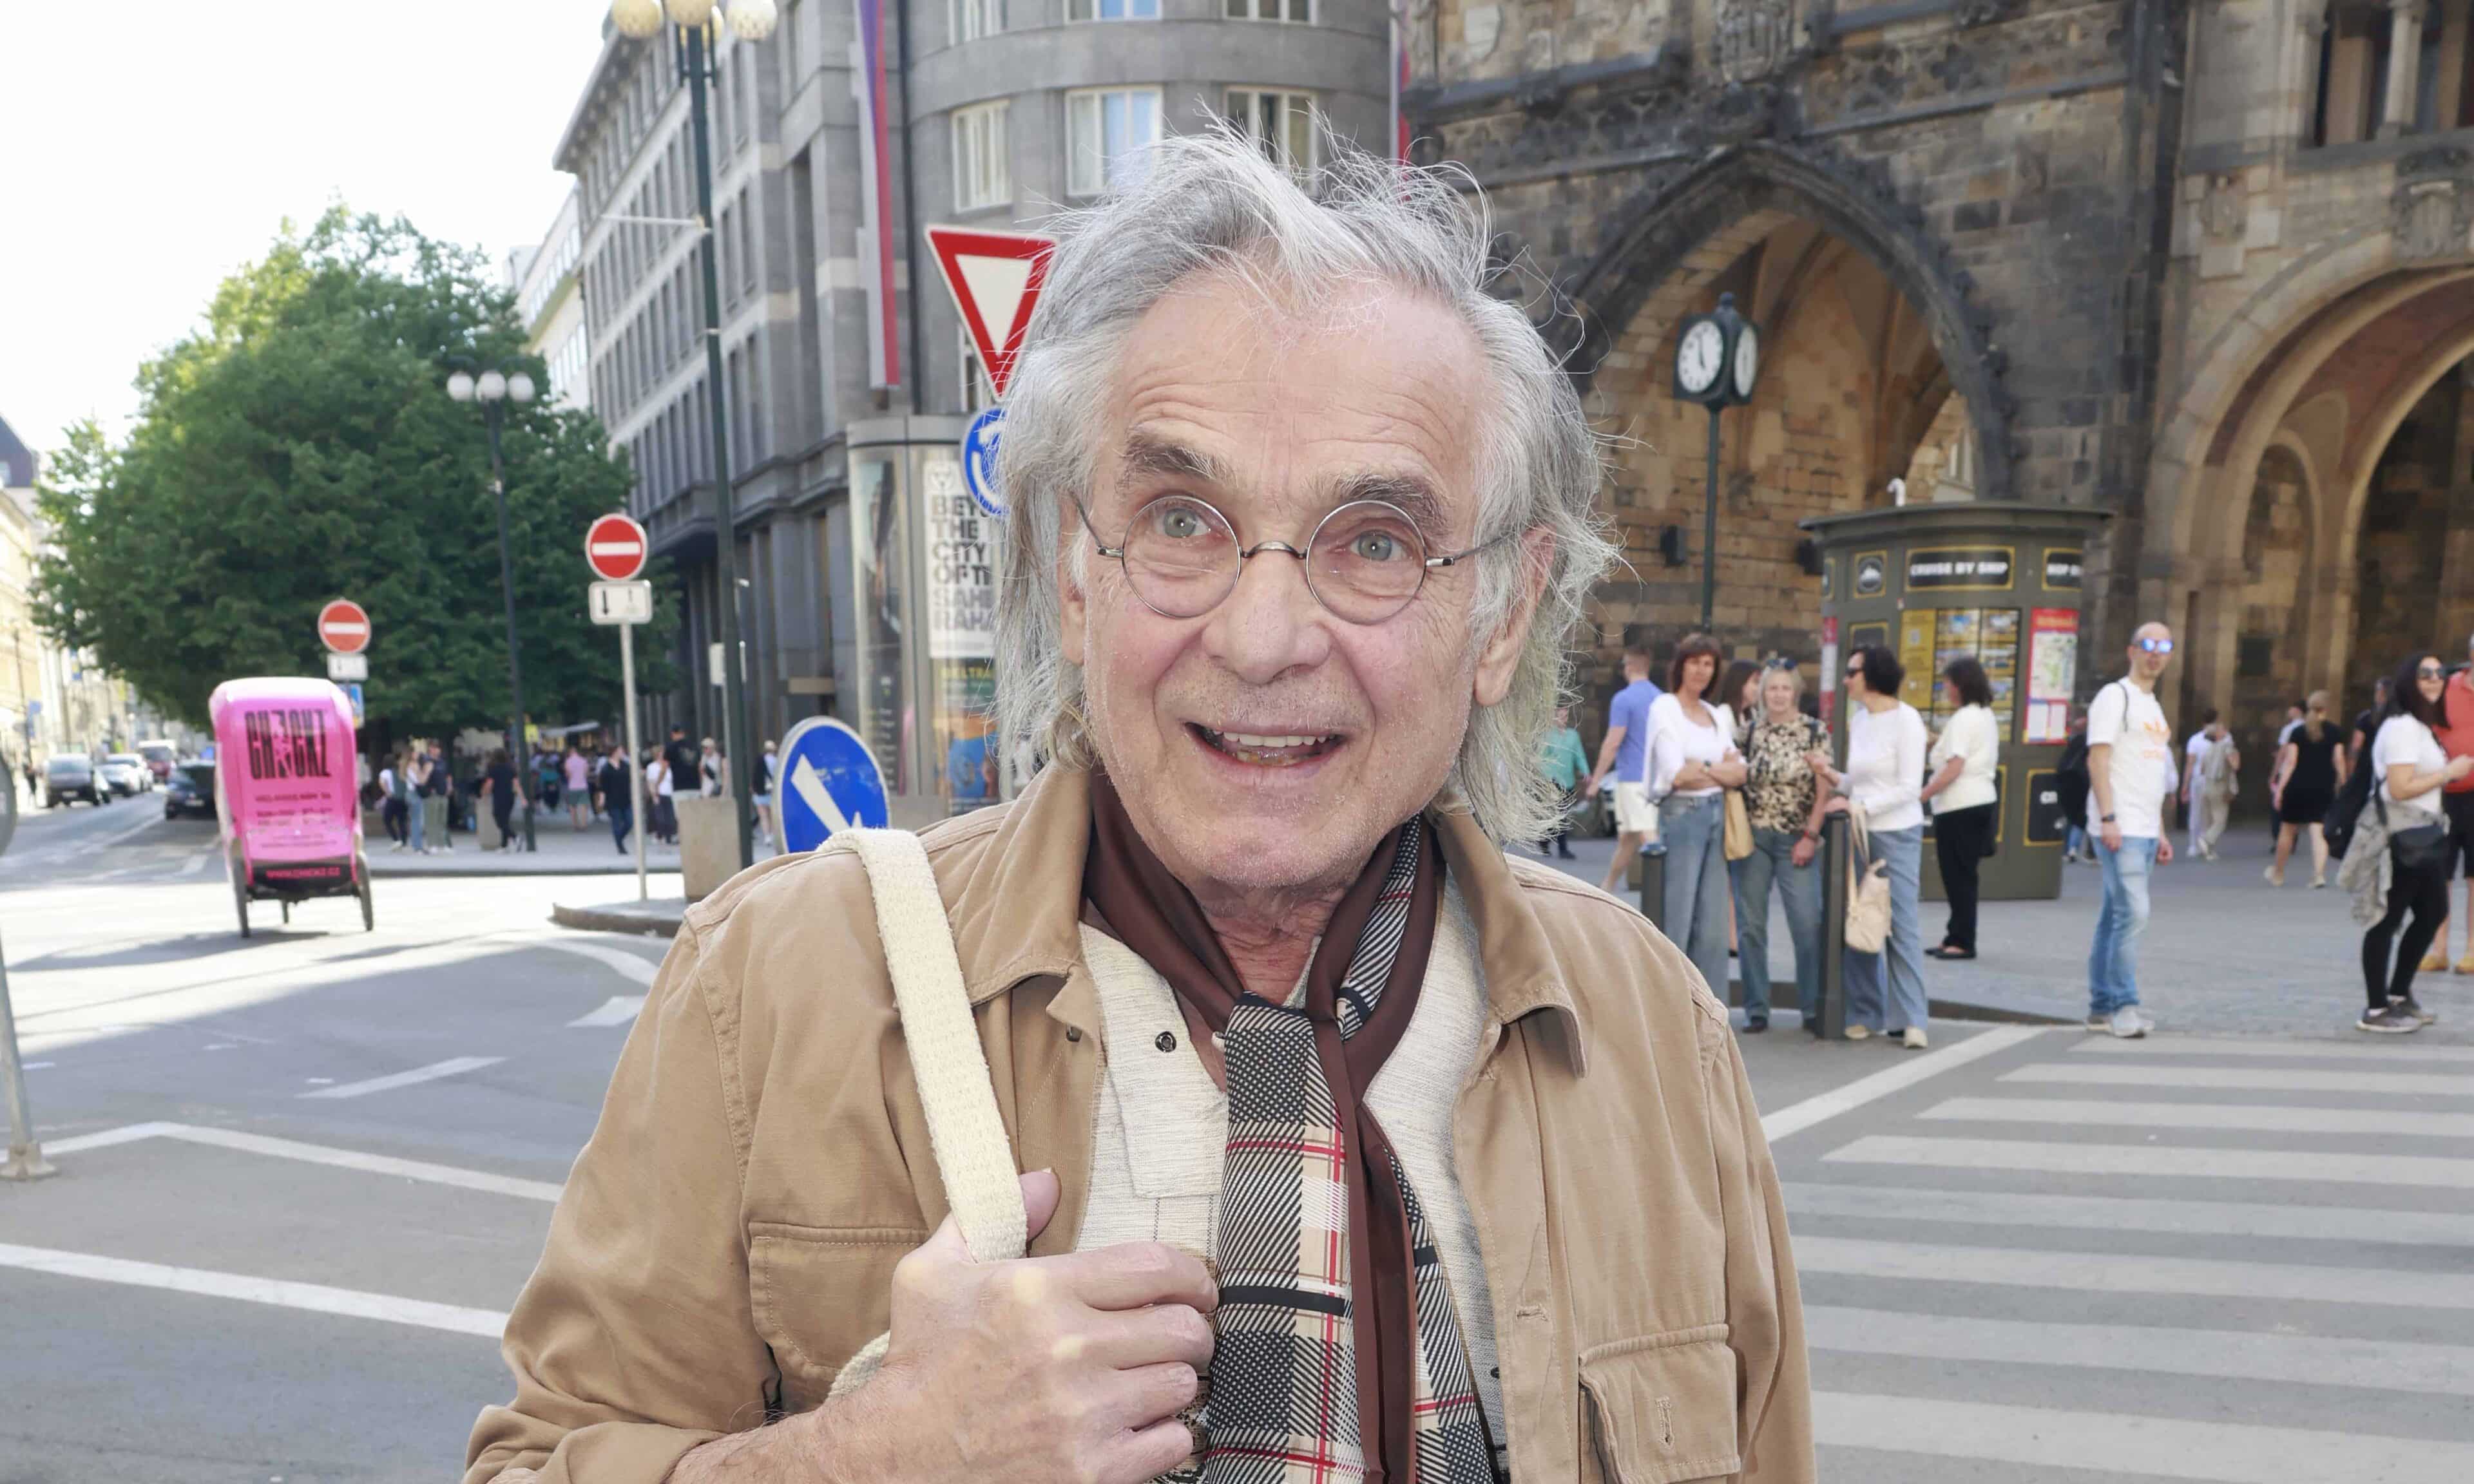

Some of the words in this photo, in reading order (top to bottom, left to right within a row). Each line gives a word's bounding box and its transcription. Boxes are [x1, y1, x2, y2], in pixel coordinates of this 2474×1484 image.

[932, 495, 990, 518] BEY
[932, 518, 979, 540] THE
[933, 542, 986, 563] CITY
[934, 565, 968, 585] OF
[1954, 561, 1976, 575] BY
